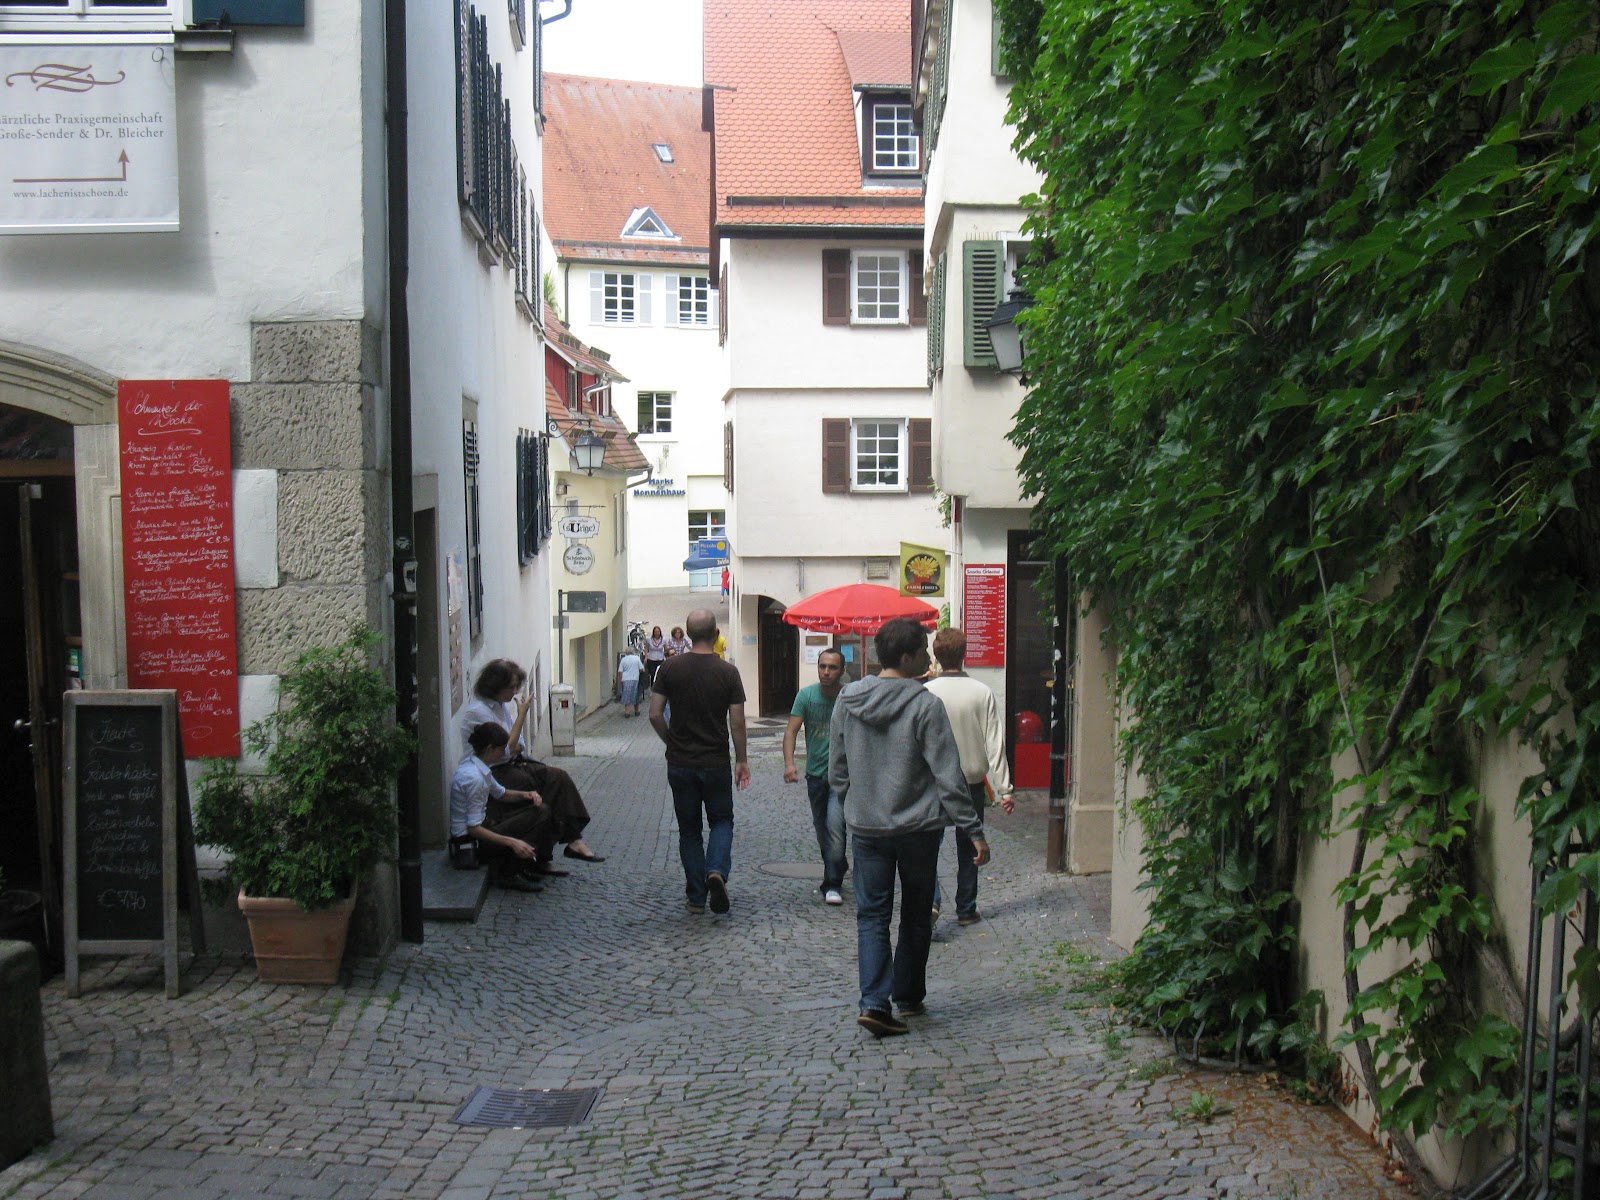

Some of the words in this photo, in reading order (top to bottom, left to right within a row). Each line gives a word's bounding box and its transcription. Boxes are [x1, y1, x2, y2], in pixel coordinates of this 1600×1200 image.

[0, 113, 50, 125] ärztliche
[55, 112, 163, 127] Praxisgemeinschaft
[79, 130, 90, 139] &
[95, 129, 113, 139] Dr.
[119, 128, 165, 138] Bleicher
[13, 188, 129, 198] www.lachenistschoen.de
[633, 489, 686, 497] Nonnenhaus
